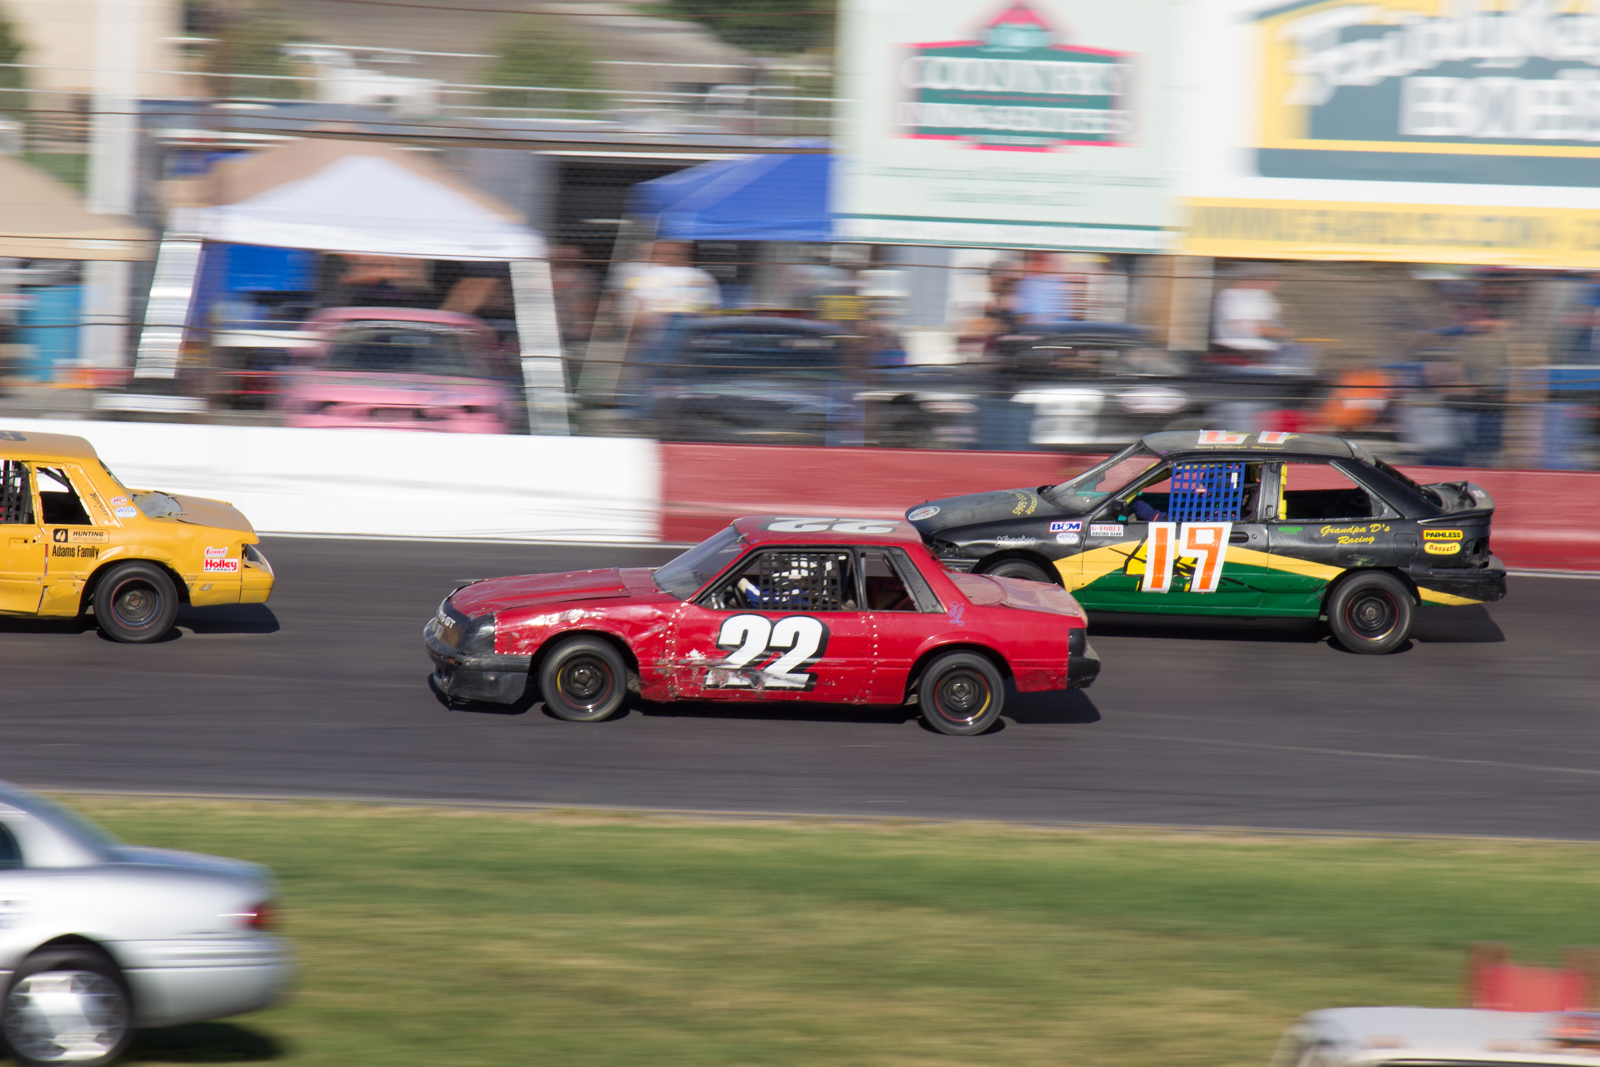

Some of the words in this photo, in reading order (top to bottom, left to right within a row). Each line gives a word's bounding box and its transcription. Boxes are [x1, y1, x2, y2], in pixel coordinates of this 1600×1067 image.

[764, 516, 902, 533] 22
[1051, 522, 1081, 532] B&M
[1320, 525, 1366, 538] Grandpa
[1369, 523, 1390, 533] D's
[1337, 535, 1376, 545] Racing
[1425, 531, 1461, 539] PAINLESS
[52, 545, 76, 558] Adams
[77, 545, 100, 560] Family
[1428, 544, 1457, 552] Bassett
[1142, 522, 1233, 593] 19
[204, 559, 238, 571] Holley
[704, 612, 829, 691] 22
